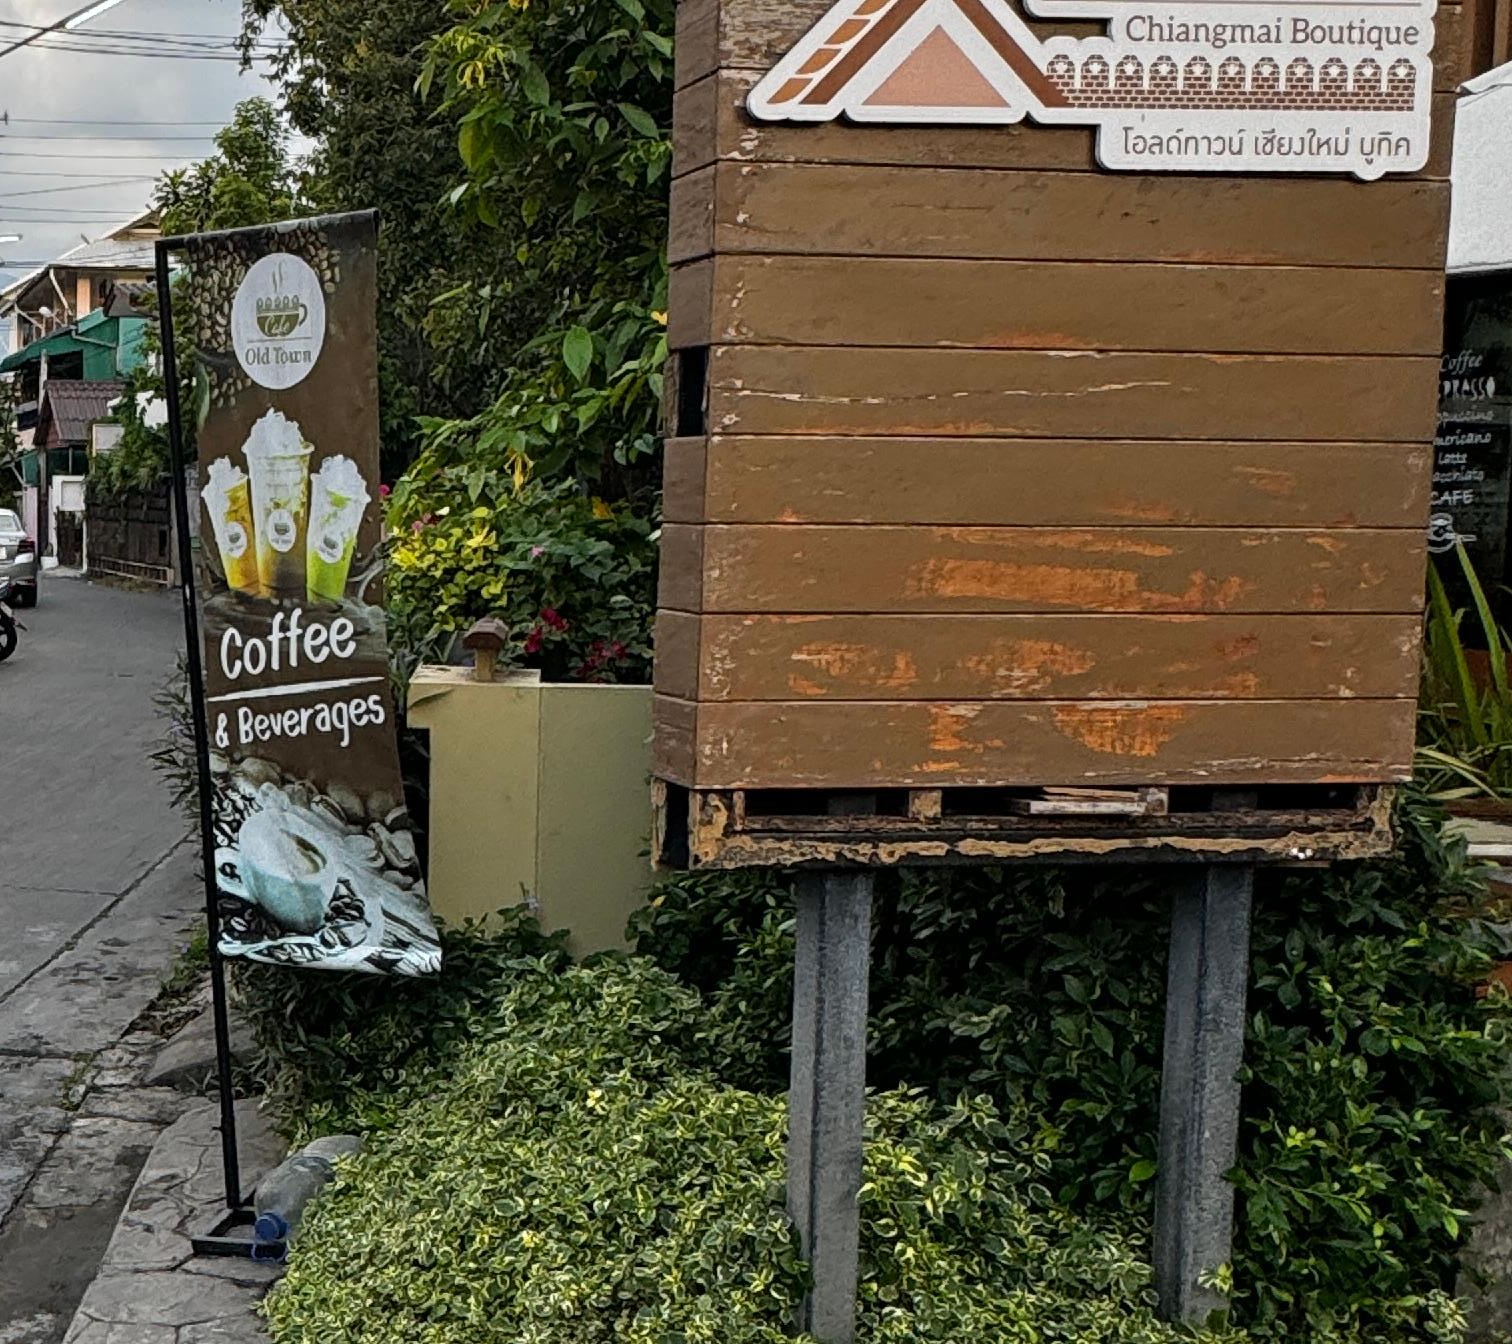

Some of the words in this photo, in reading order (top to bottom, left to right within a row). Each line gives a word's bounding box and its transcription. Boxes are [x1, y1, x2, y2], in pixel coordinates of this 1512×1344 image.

[1125, 14, 1283, 50] Chiangmai
[1291, 17, 1420, 51] Boutique
[1253, 126, 1351, 157] เชียงใหม่
[245, 347, 270, 365] Old
[273, 346, 312, 365] Town
[220, 608, 356, 680] Coffee
[215, 713, 230, 749] &
[238, 695, 385, 748] Beverages
